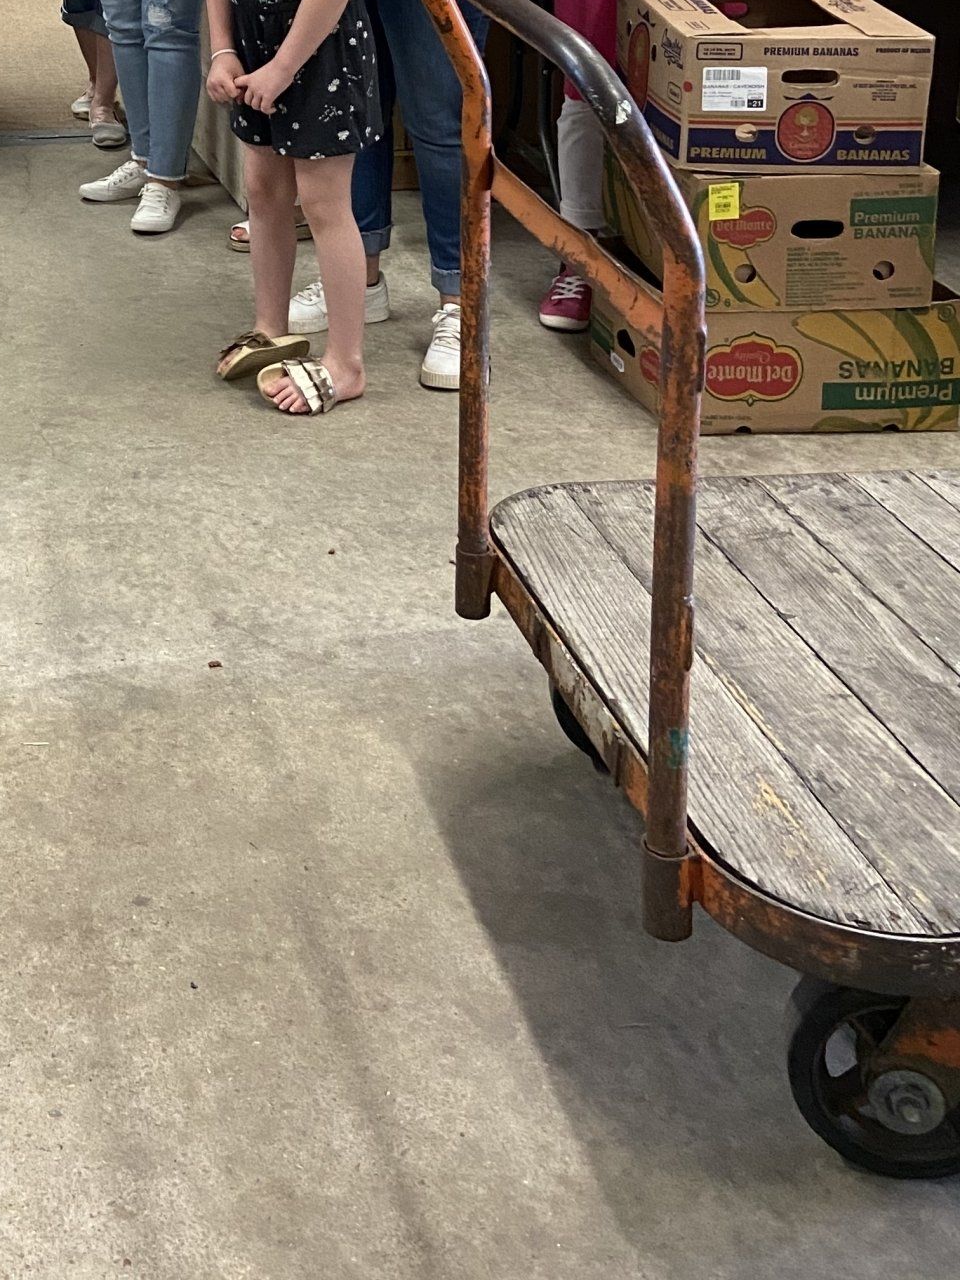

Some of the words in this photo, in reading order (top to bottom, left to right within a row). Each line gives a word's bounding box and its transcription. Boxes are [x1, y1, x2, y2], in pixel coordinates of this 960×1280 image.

[763, 47, 810, 56] PREMIUM
[812, 47, 860, 56] BANANAS
[690, 147, 766, 159] PREMIUM
[836, 149, 910, 161] BANANAS
[854, 211, 920, 224] Premium
[708, 364, 764, 383] Monte
[767, 364, 793, 382] Del
[838, 357, 955, 379] BANANAS
[855, 382, 953, 404] Premium
